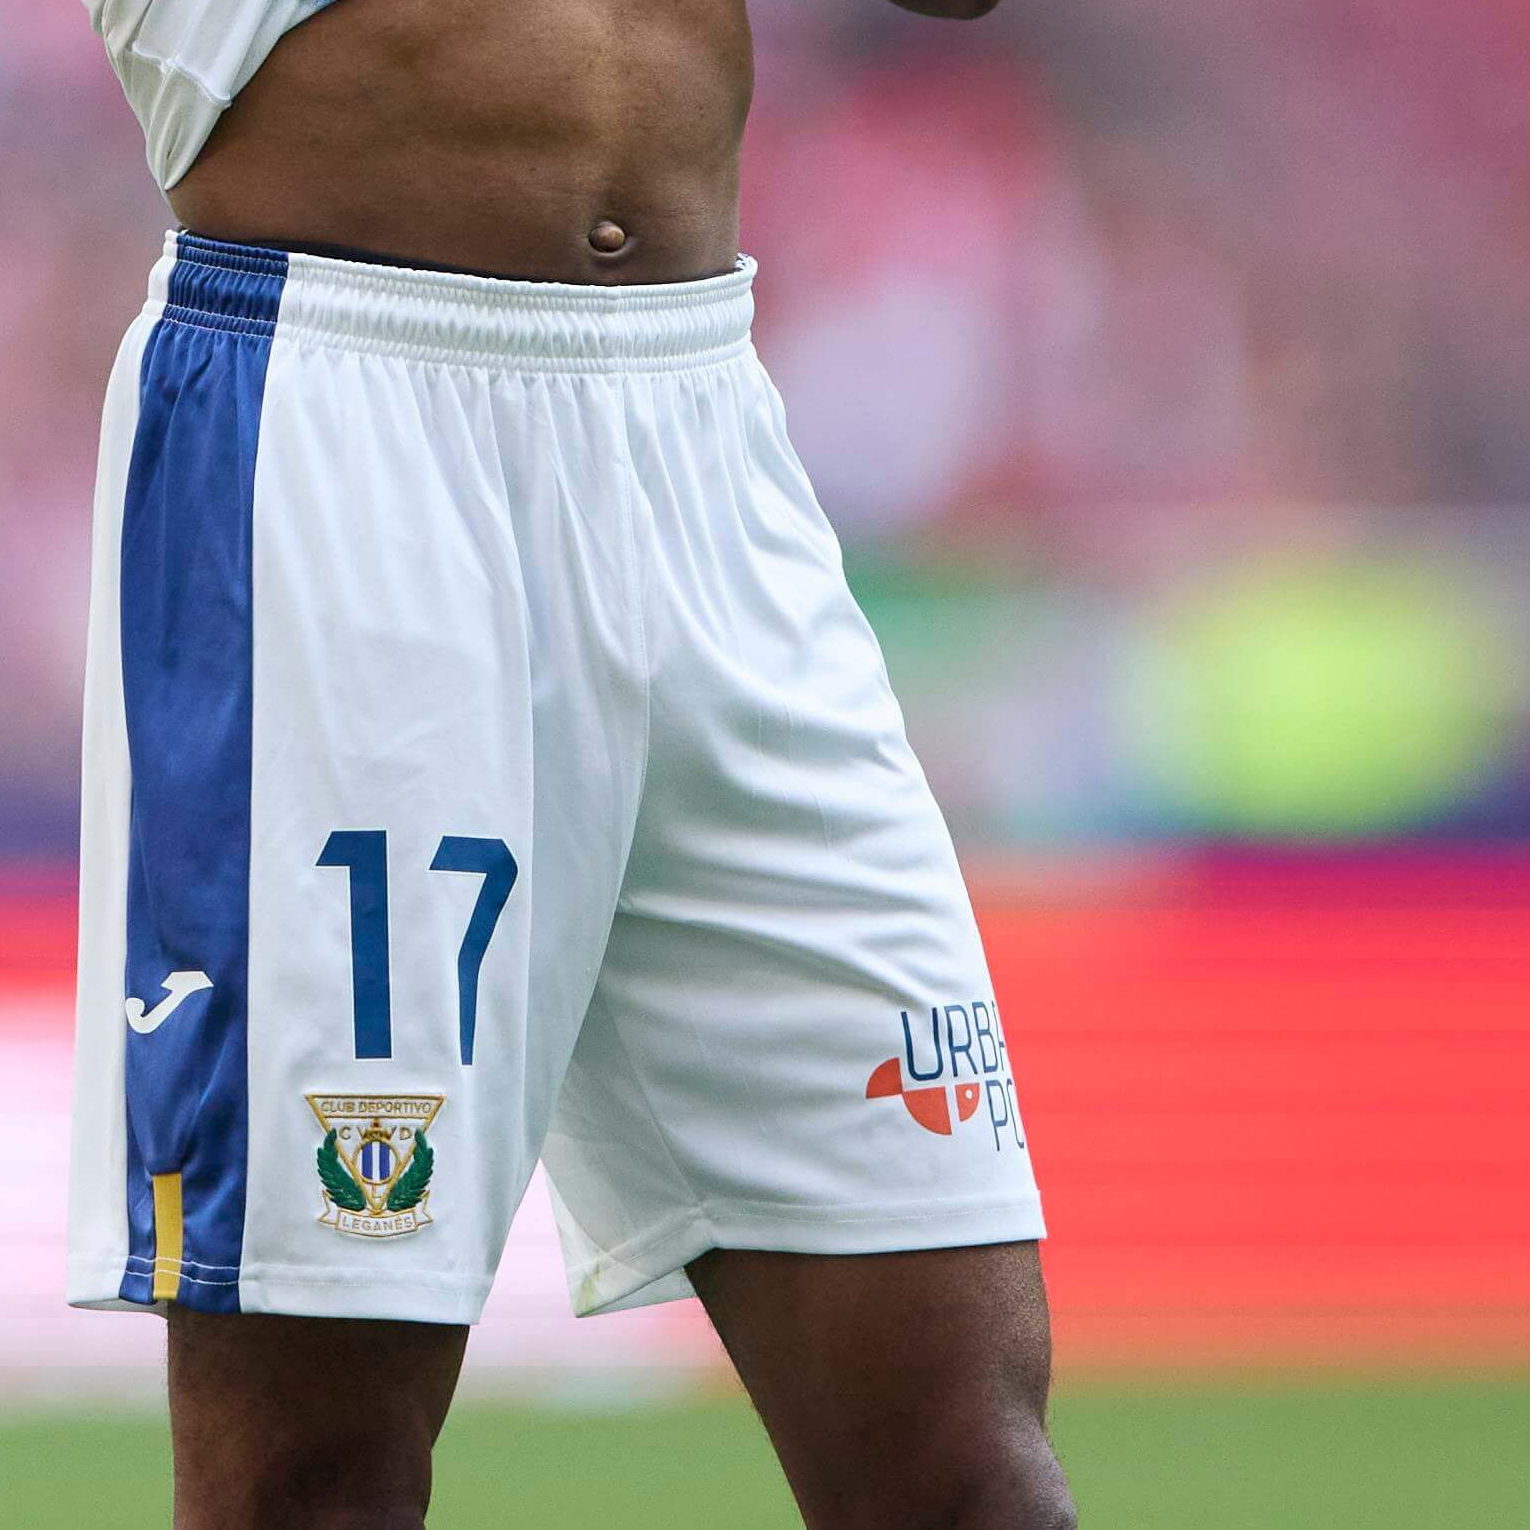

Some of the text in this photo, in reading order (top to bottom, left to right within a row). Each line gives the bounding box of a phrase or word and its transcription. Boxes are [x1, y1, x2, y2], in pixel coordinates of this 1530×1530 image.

[315, 829, 518, 1065] 17
[321, 1101, 431, 1113] CLUB DEPORTIVO
